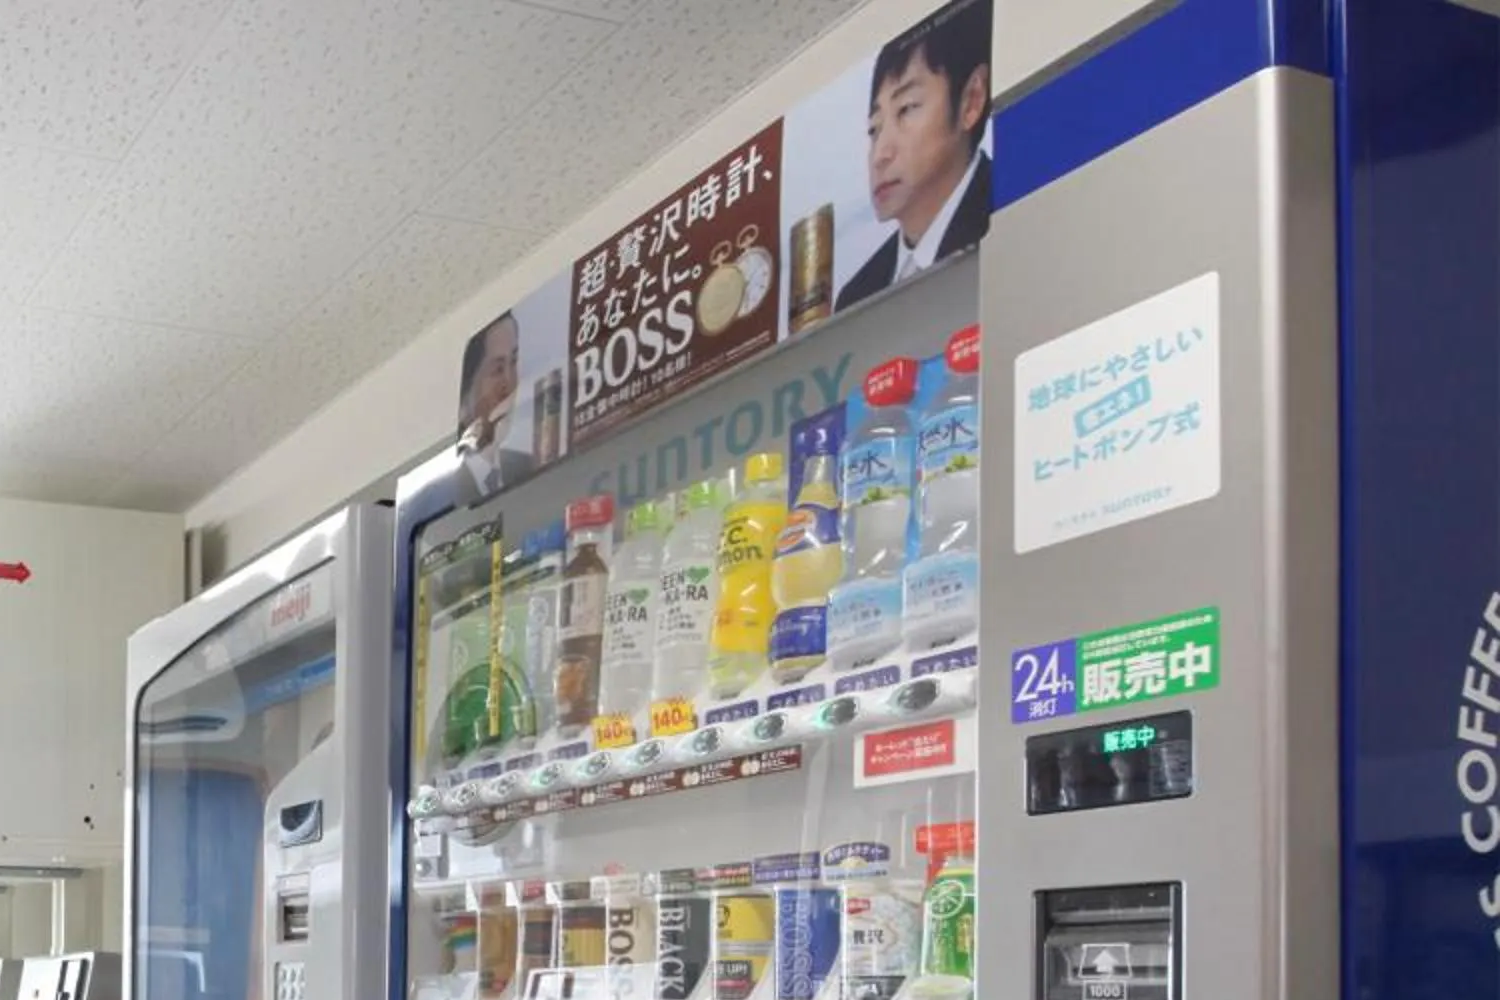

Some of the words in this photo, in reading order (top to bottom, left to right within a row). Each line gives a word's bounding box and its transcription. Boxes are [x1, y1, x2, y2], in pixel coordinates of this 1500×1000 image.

[575, 243, 701, 347] あなたに。
[574, 289, 694, 408] BOSS
[1028, 327, 1203, 411] 地球にやさしい
[1014, 647, 1075, 703] 24h
[1082, 641, 1212, 707] 販売中
[1103, 726, 1156, 752] 販売中
[659, 906, 687, 996] BLACK
[1090, 984, 1121, 998] 1000
